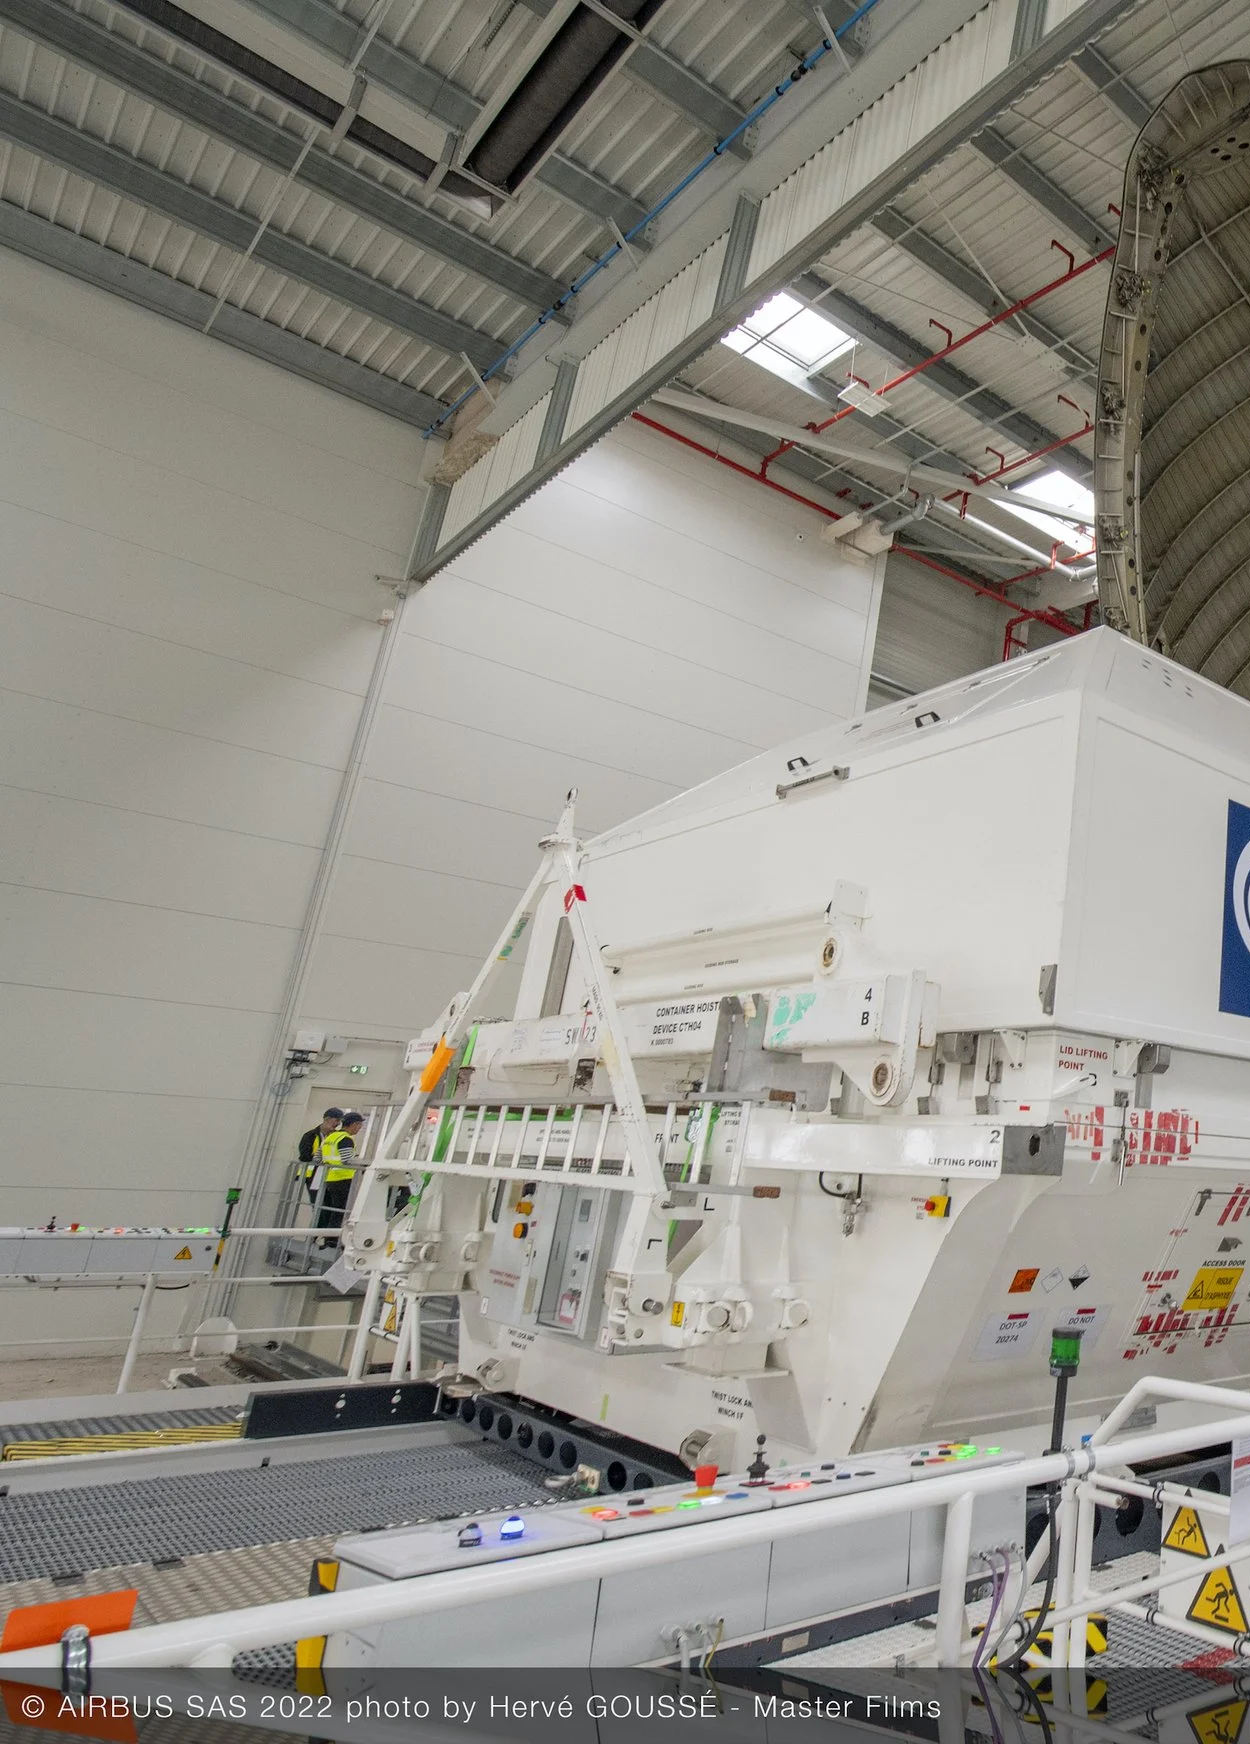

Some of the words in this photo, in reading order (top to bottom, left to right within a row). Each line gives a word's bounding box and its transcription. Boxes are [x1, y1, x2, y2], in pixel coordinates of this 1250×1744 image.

[864, 987, 873, 1002] 4
[656, 1003, 696, 1018] CONTAINER
[696, 1000, 721, 1013] HOISTI
[861, 1011, 870, 1026] B
[652, 1023, 679, 1034] DEVICE
[679, 1021, 702, 1033] CTH04
[1060, 1045, 1074, 1055] LID
[1075, 1048, 1108, 1060] LIFTING
[1058, 1060, 1085, 1071] POINT
[654, 1133, 680, 1143] FRNT
[988, 1129, 1001, 1144] 2
[928, 1157, 966, 1167] LIFTING
[968, 1159, 998, 1168] POINT
[999, 1321, 1028, 1332] DOT-SP
[1067, 1317, 1079, 1326] DO
[1079, 1316, 1096, 1324] NOT
[994, 1334, 1019, 1344] 20274
